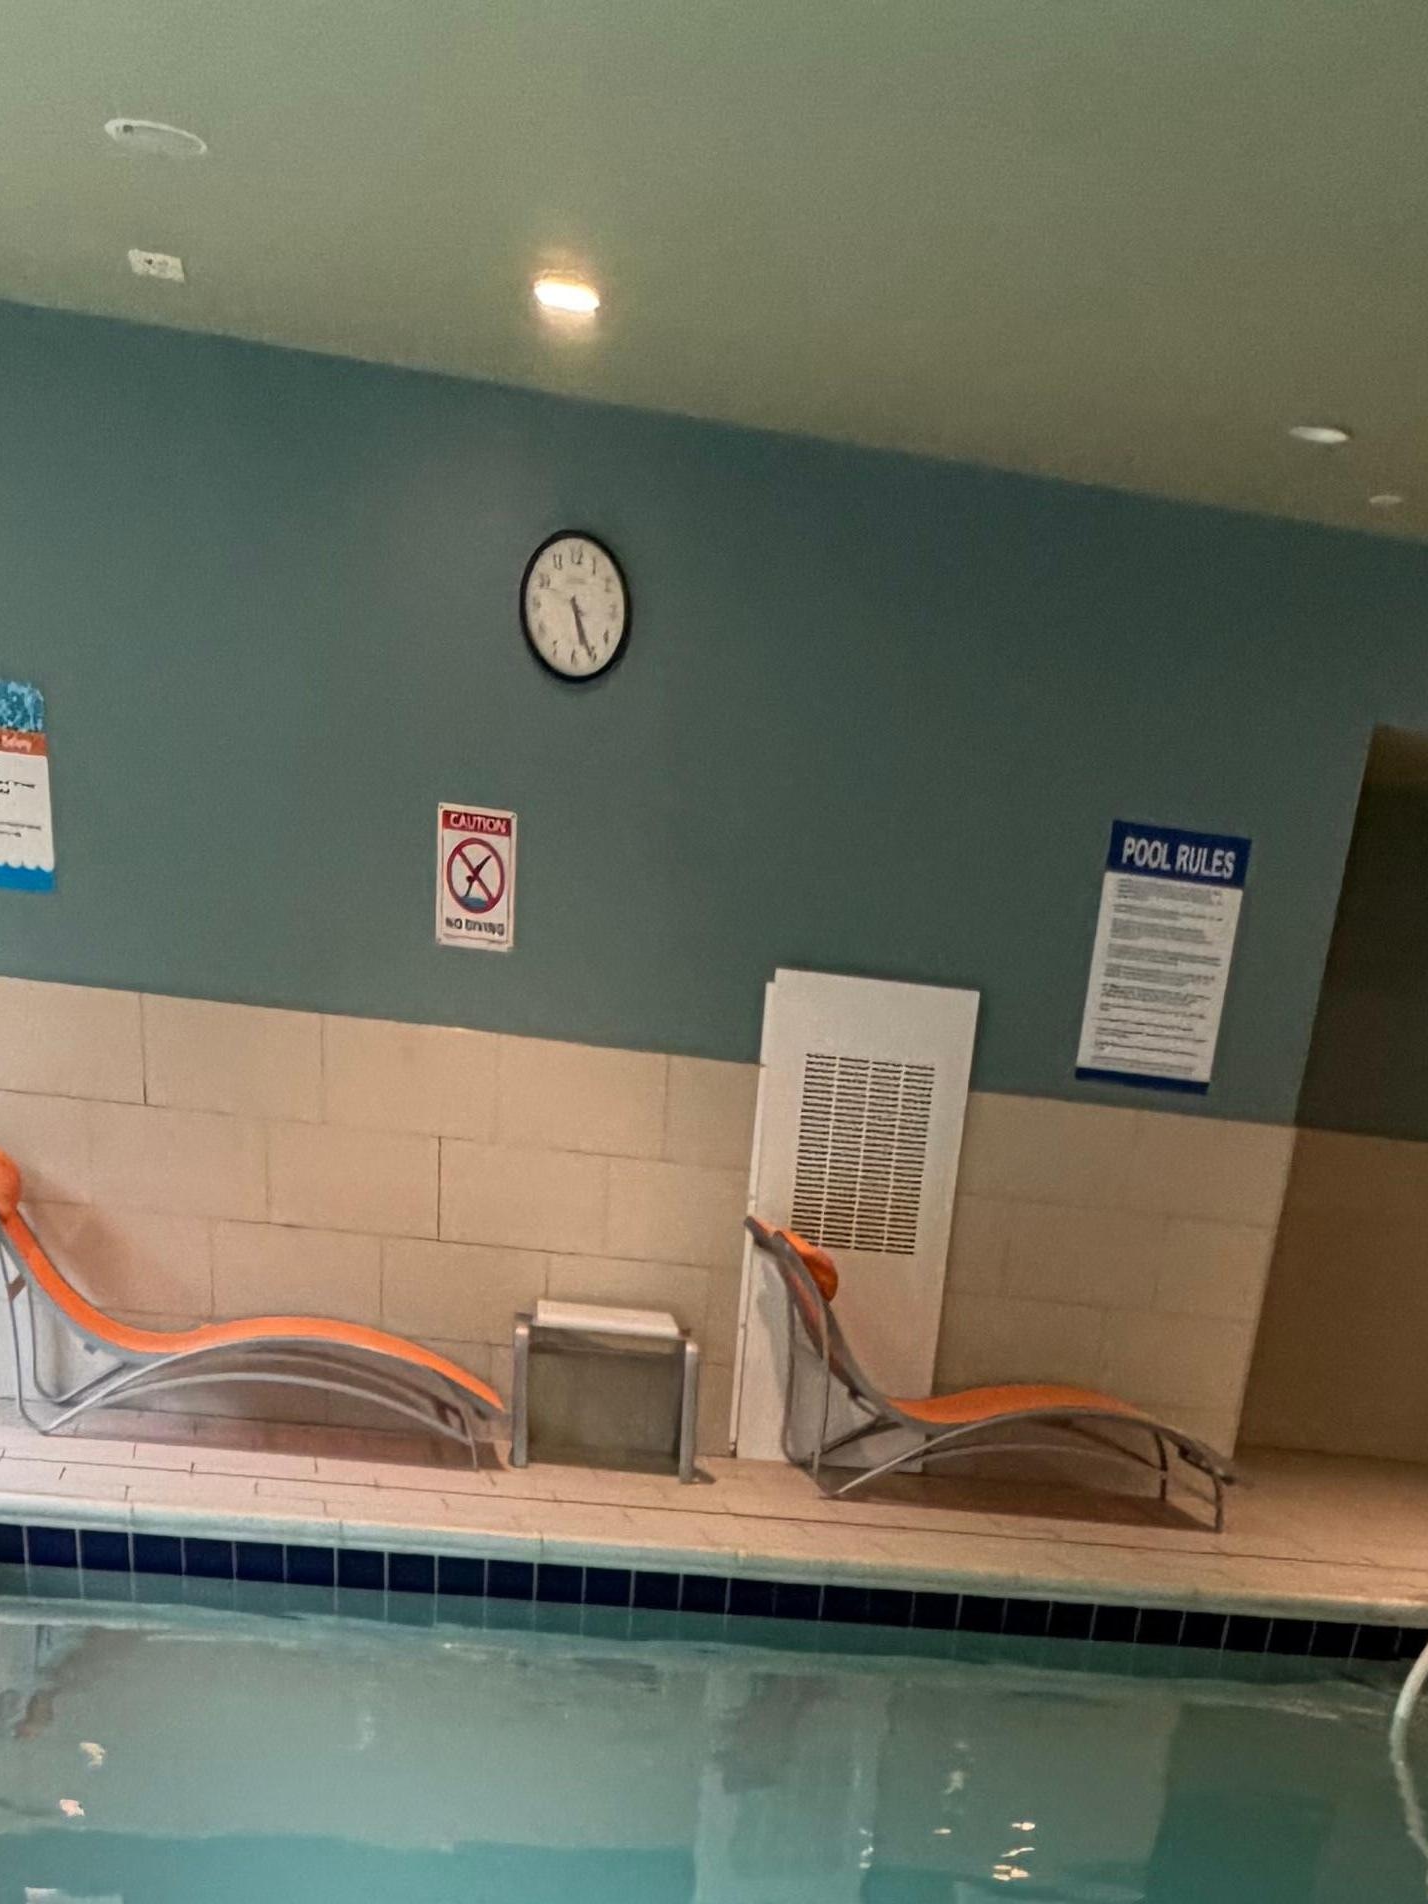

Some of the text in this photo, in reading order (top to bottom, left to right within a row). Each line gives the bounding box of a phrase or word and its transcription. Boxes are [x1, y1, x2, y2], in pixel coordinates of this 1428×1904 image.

[449, 813, 507, 833] CAUTION
[1122, 836, 1236, 879] POOL RULES
